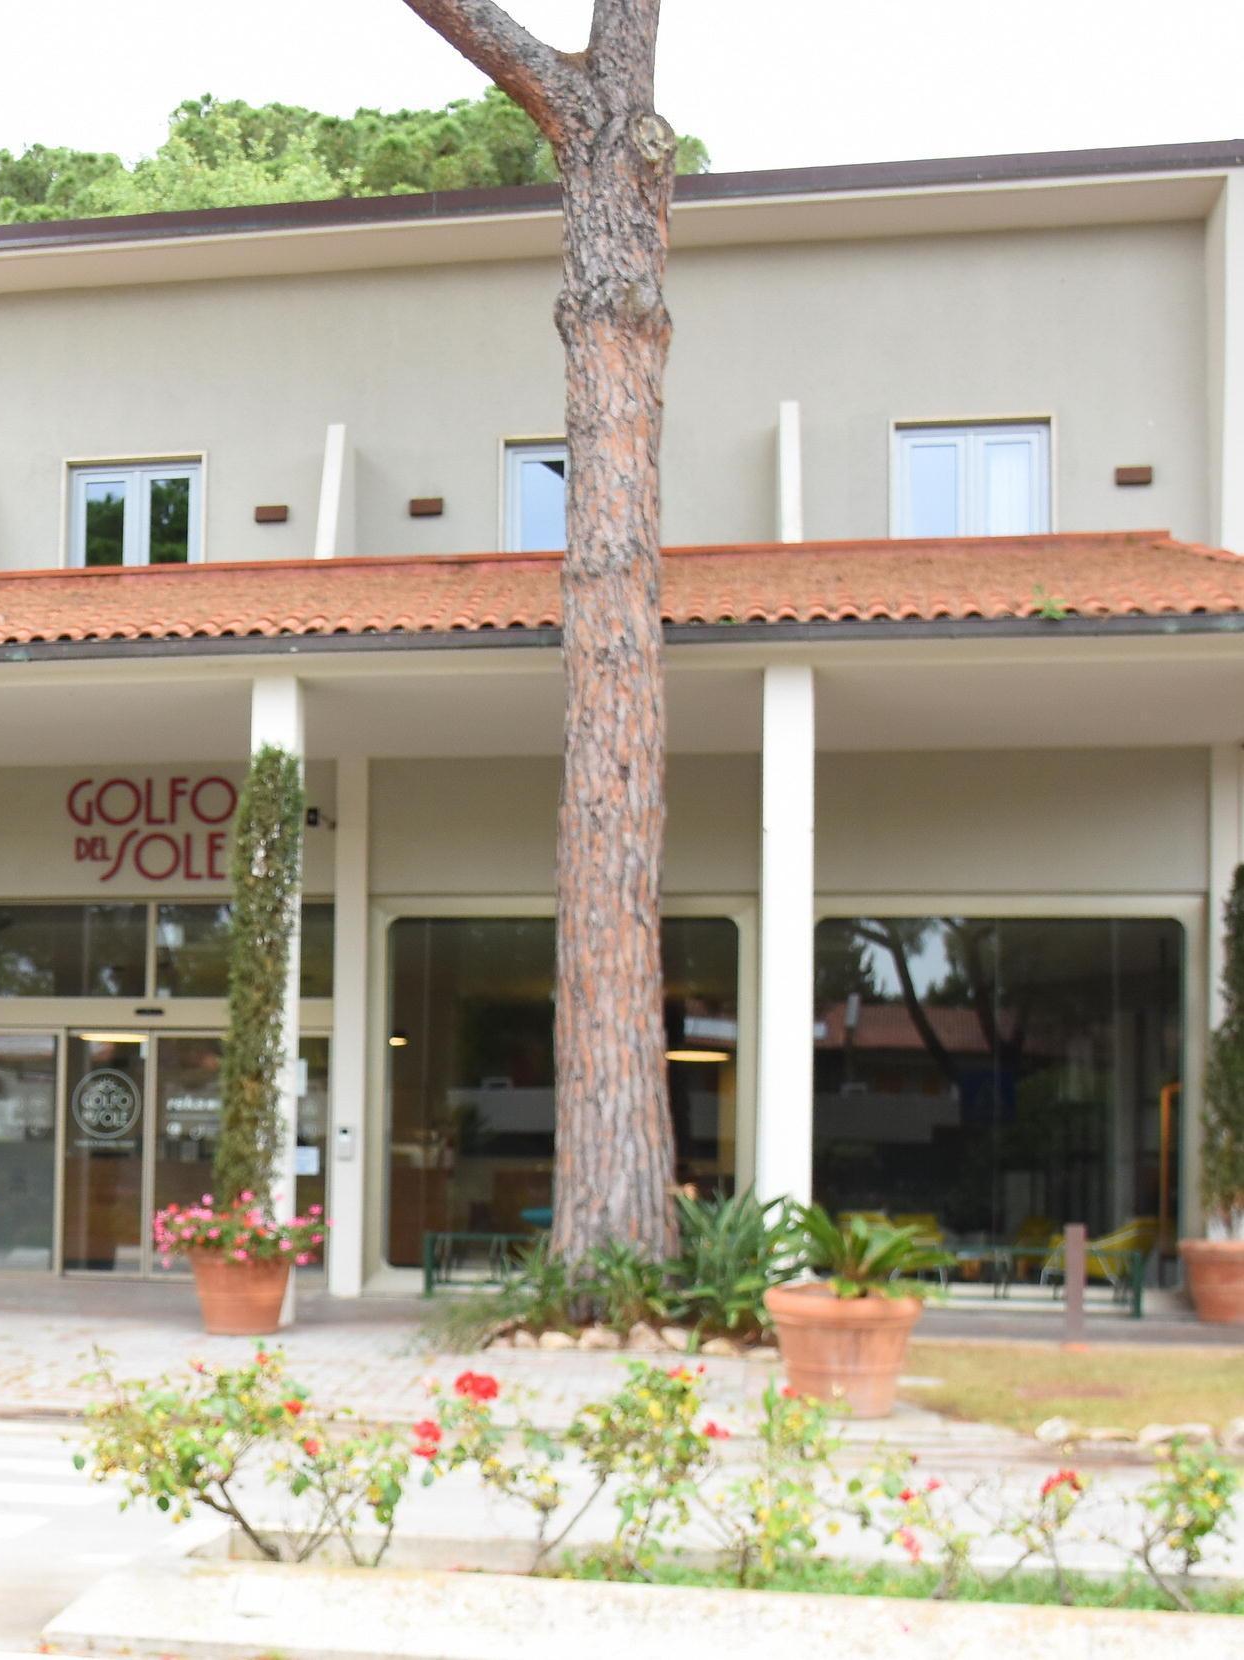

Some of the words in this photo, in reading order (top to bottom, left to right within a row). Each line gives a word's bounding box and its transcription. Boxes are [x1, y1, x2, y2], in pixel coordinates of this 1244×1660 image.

[67, 776, 238, 826] GOLFO
[74, 836, 110, 862] DEL
[99, 828, 227, 882] SOLE
